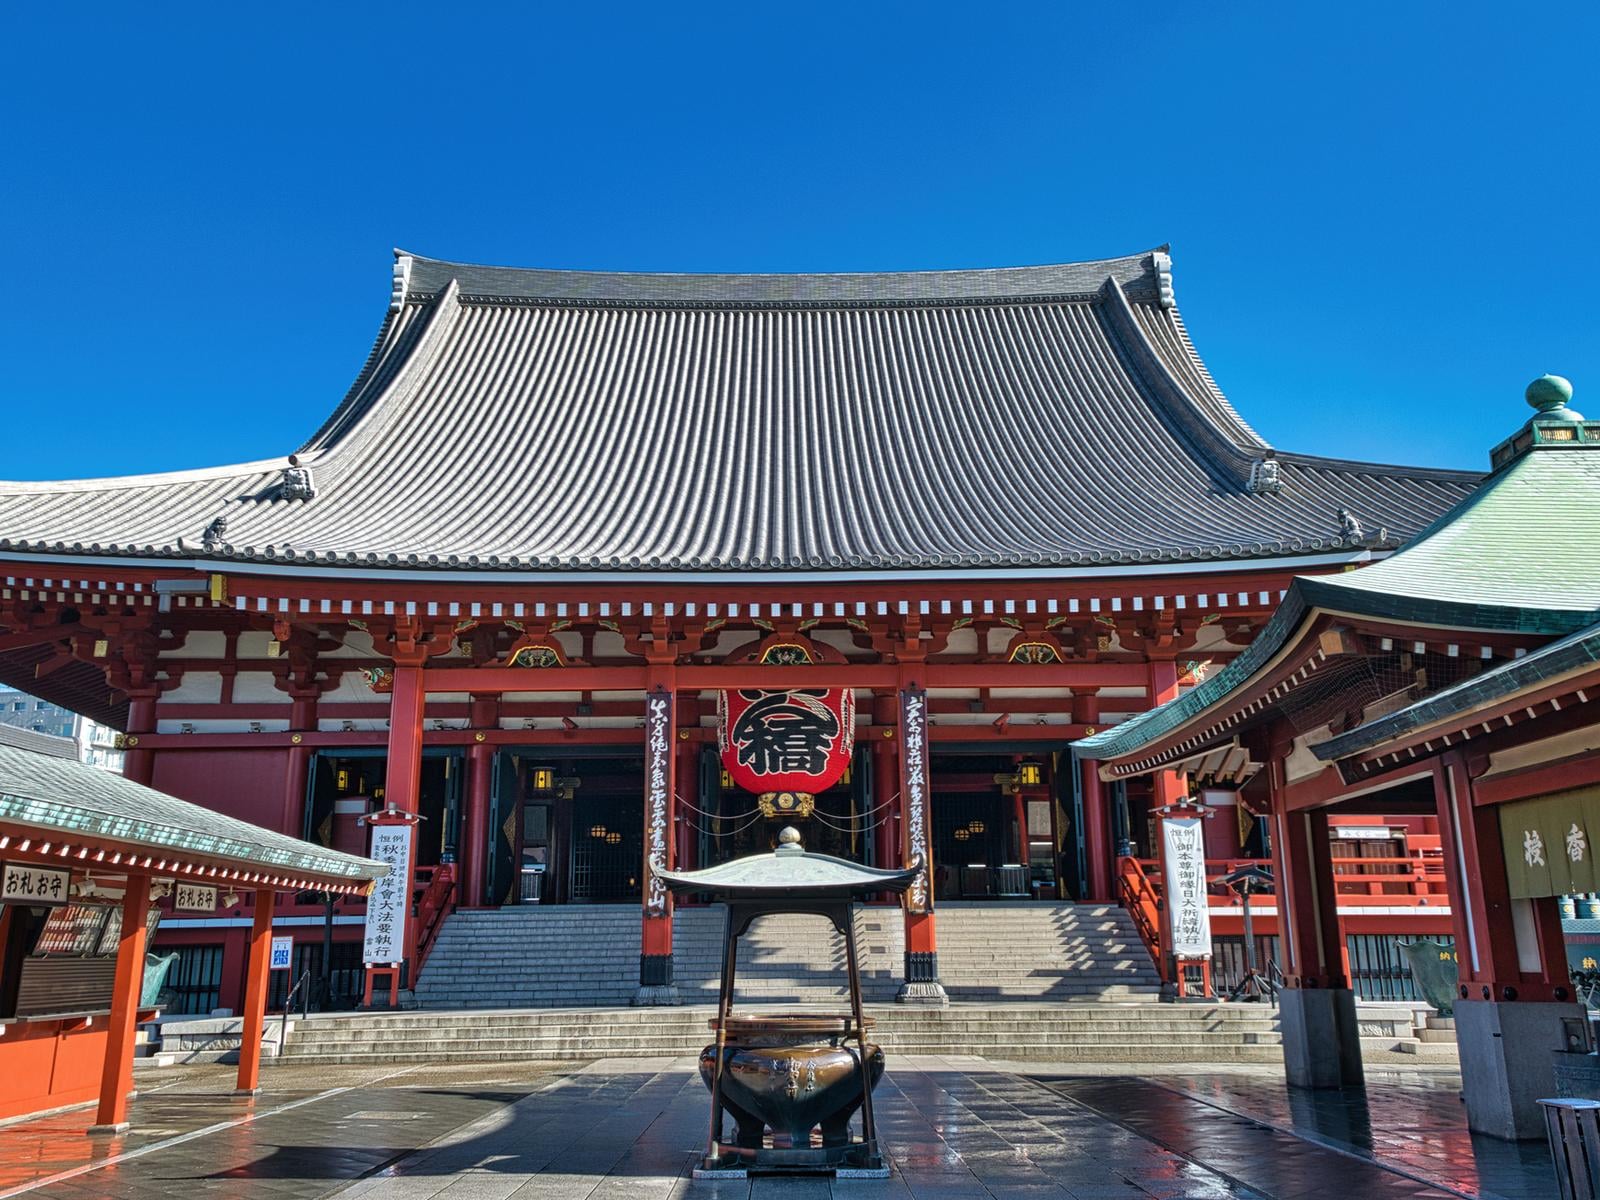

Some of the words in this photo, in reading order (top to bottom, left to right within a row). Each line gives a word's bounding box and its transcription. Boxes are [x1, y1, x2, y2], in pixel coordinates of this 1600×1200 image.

[379, 834, 404, 843] 恒例
[1170, 828, 1195, 837] 恒例
[6, 870, 62, 898] お札お守
[178, 889, 213, 908] お札お守
